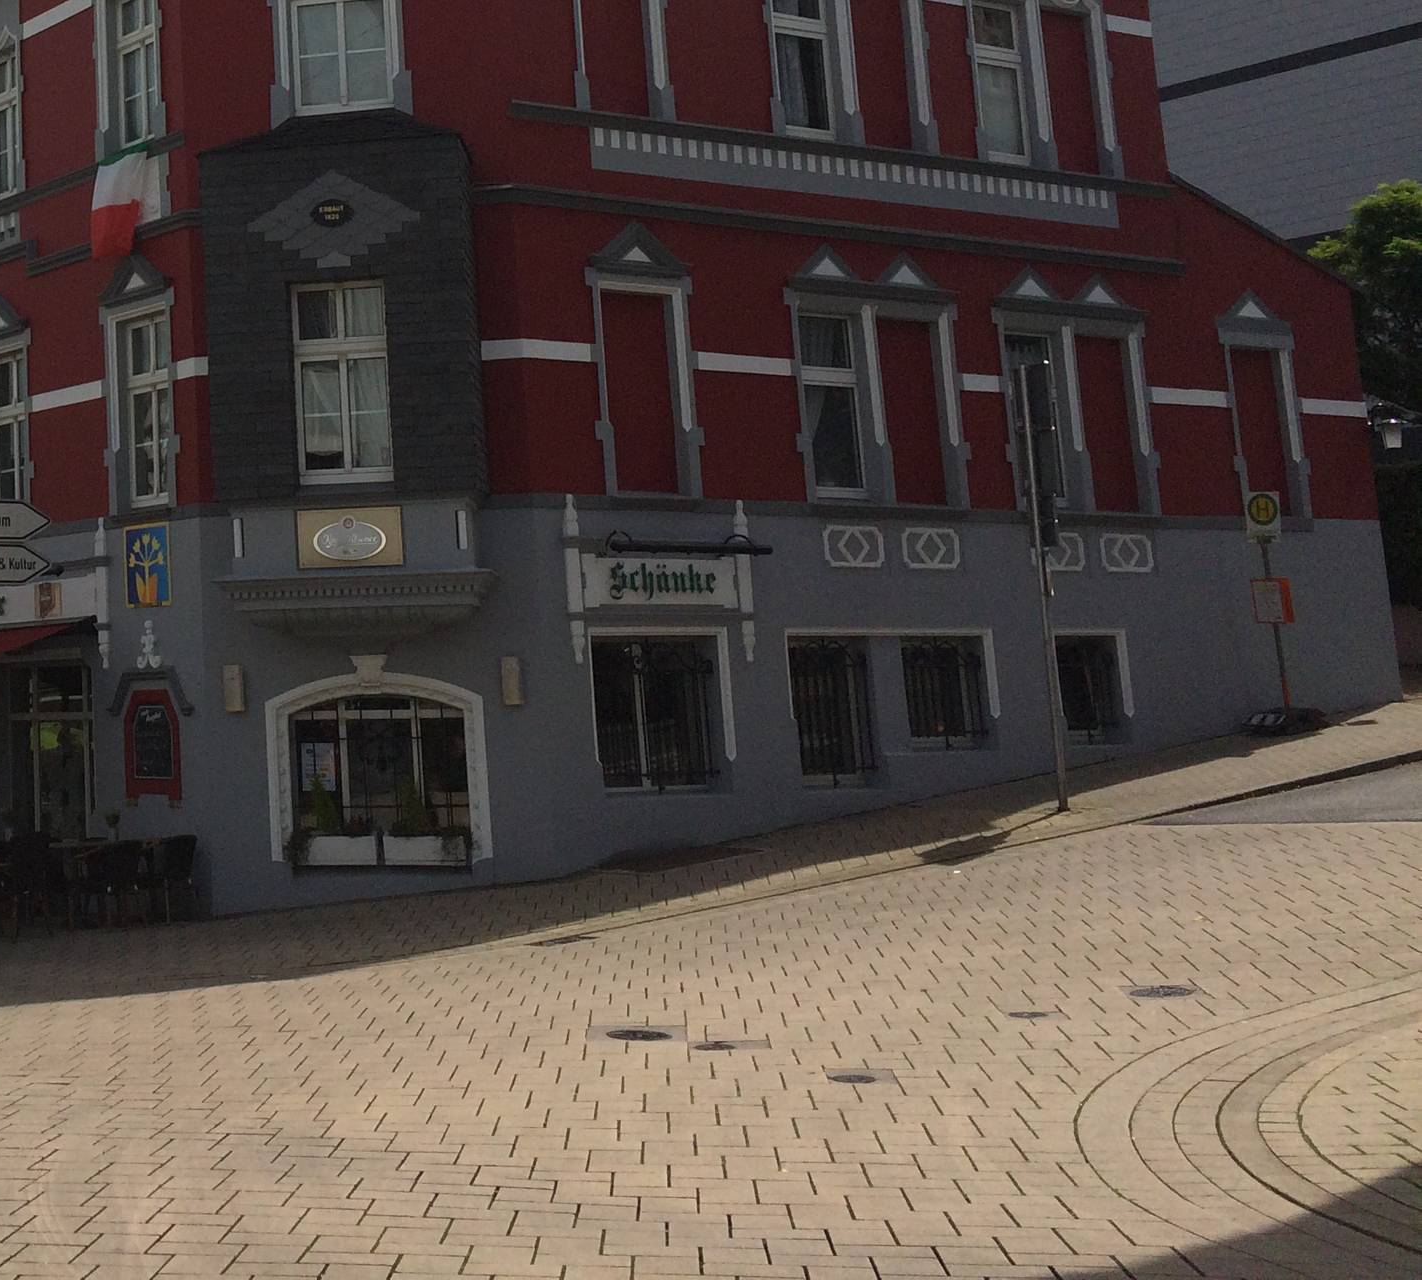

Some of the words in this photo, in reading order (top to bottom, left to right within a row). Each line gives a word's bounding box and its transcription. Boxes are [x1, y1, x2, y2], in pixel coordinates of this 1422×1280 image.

[1256, 500, 1270, 516] H
[8, 557, 37, 570] Kultur
[609, 561, 716, 600] Schänke
